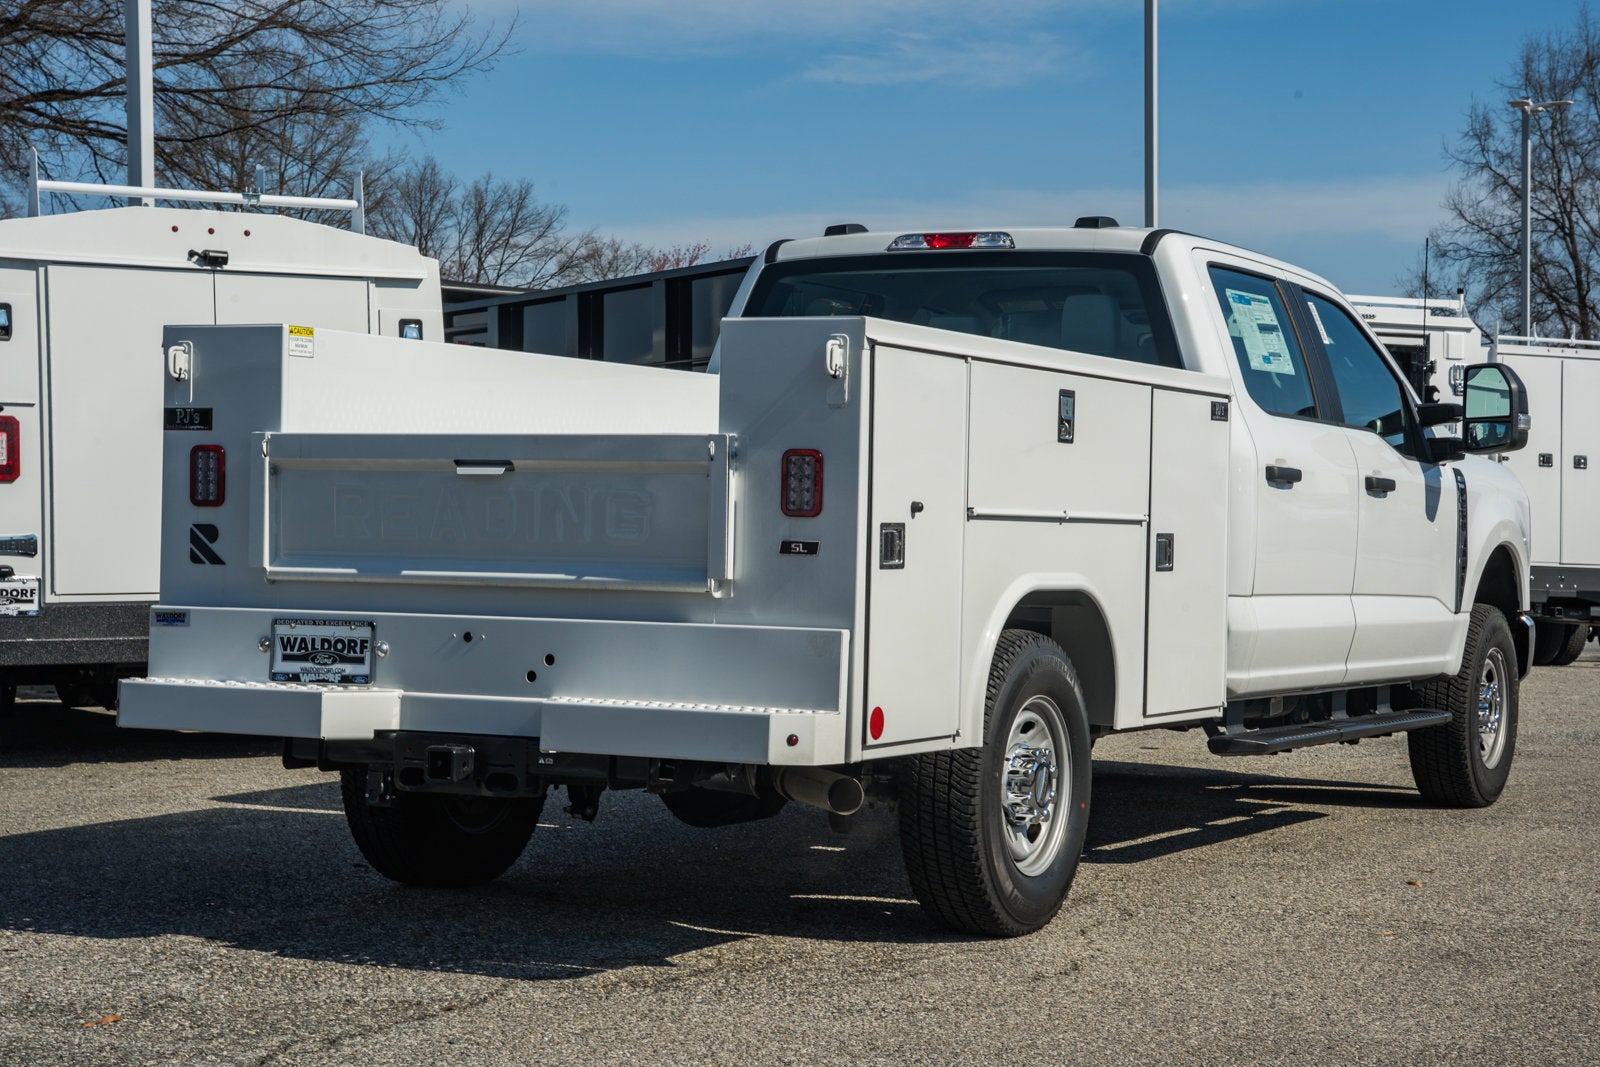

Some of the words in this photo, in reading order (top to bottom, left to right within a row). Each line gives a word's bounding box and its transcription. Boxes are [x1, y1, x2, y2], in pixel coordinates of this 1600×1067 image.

[294, 327, 314, 336] CAUTION
[175, 408, 201, 424] PJ's
[331, 482, 653, 545] READING
[0, 588, 36, 598] DORF
[279, 635, 369, 655] WALDORF
[314, 654, 334, 665] Ford
[299, 673, 342, 683] WALDORF
